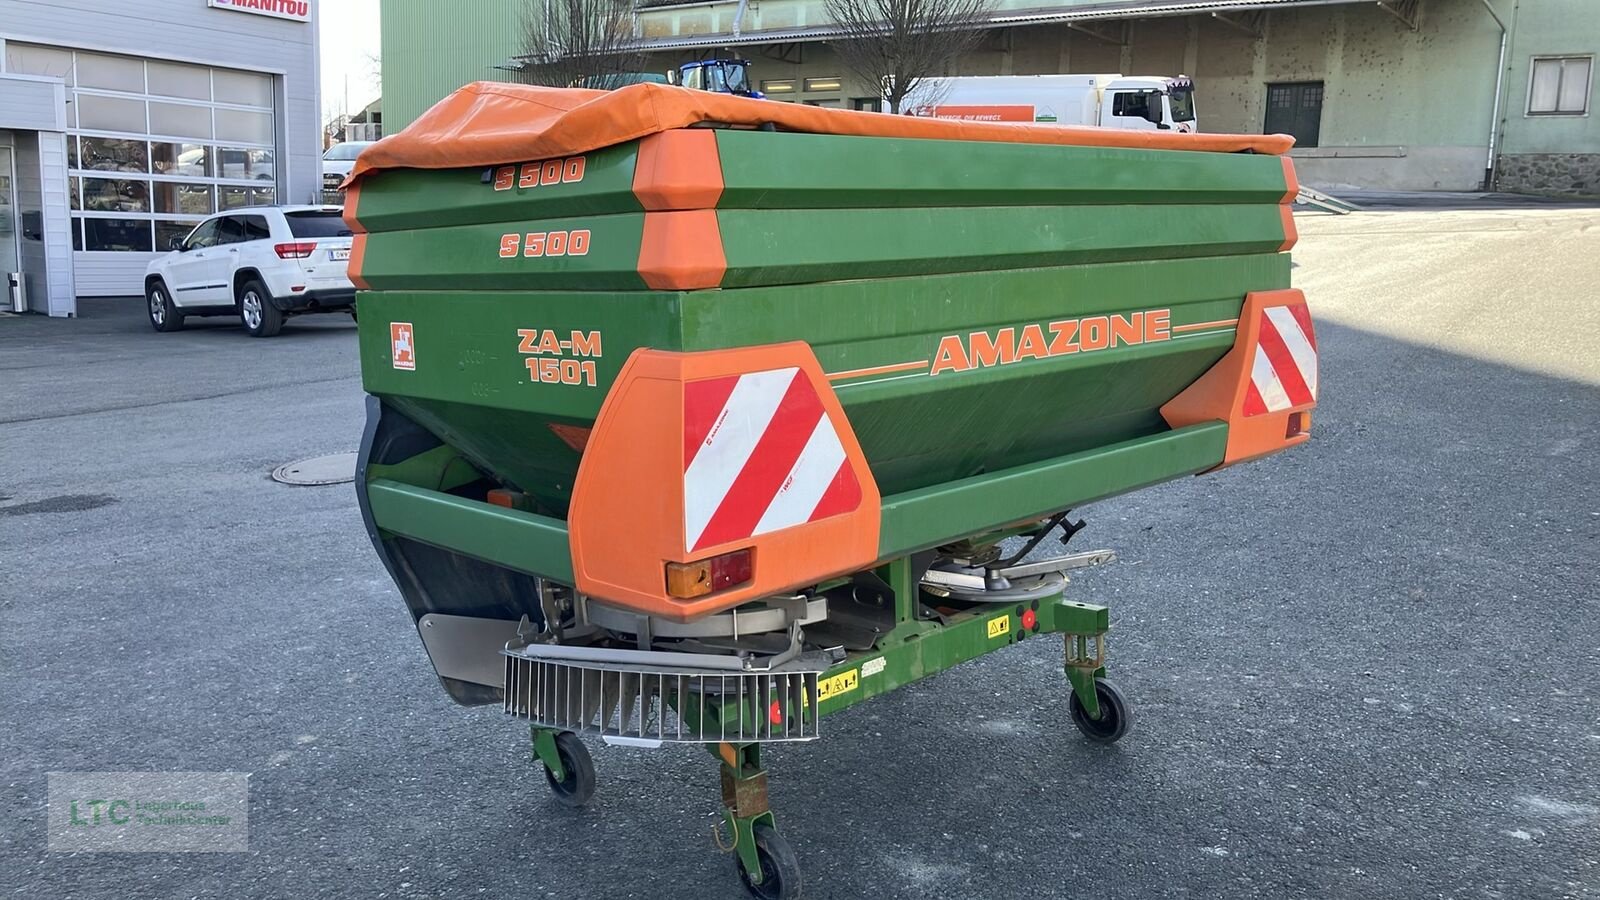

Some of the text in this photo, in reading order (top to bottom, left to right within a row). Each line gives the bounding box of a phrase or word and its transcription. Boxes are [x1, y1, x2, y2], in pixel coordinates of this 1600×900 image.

[494, 156, 586, 191] S 500
[499, 229, 591, 258] S 500
[517, 328, 602, 357] ZA-M
[930, 309, 1170, 376] AMAZONE
[525, 357, 597, 387] 1501
